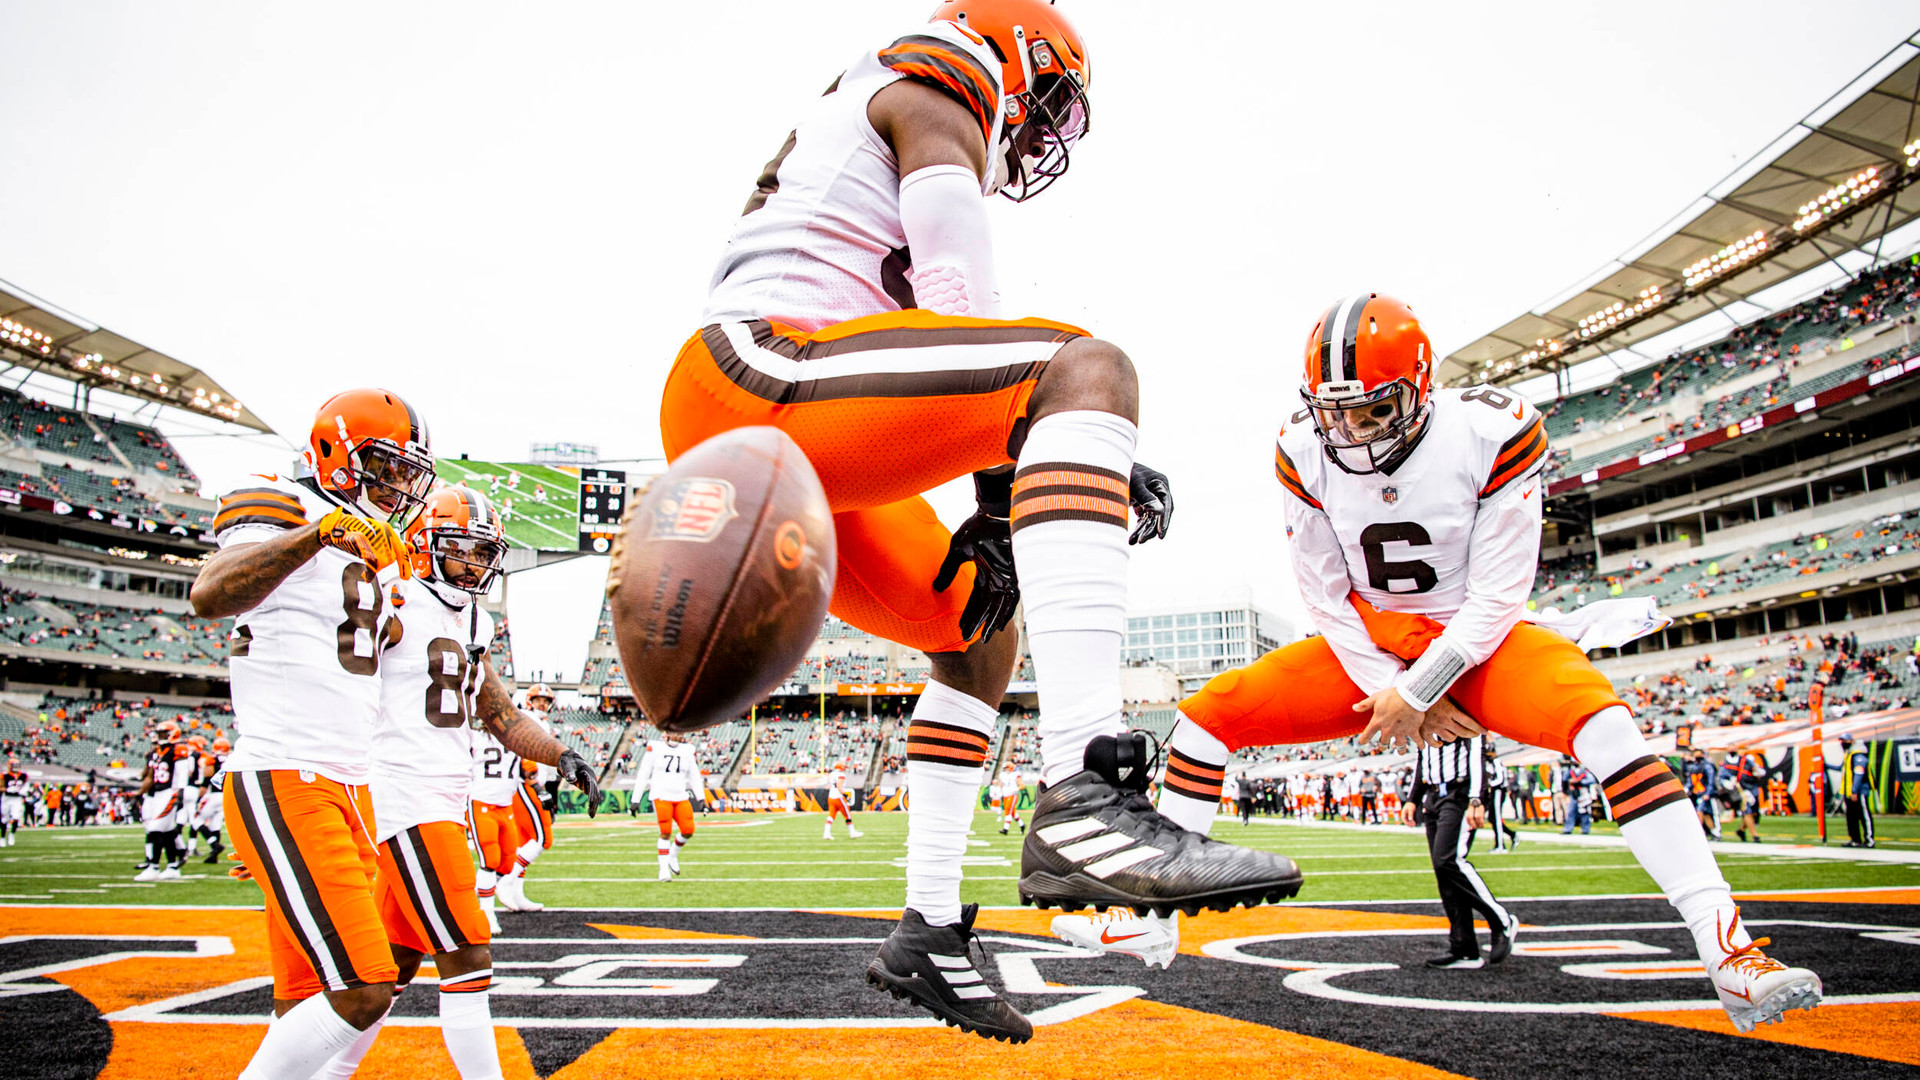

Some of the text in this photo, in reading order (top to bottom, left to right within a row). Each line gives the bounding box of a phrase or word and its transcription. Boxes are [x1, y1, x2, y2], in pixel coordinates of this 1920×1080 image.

[679, 484, 722, 533] NFL
[1359, 521, 1439, 595] 6
[661, 578, 693, 648] Wilson
[664, 754, 683, 774] 71
[730, 791, 778, 800] TICKETS
